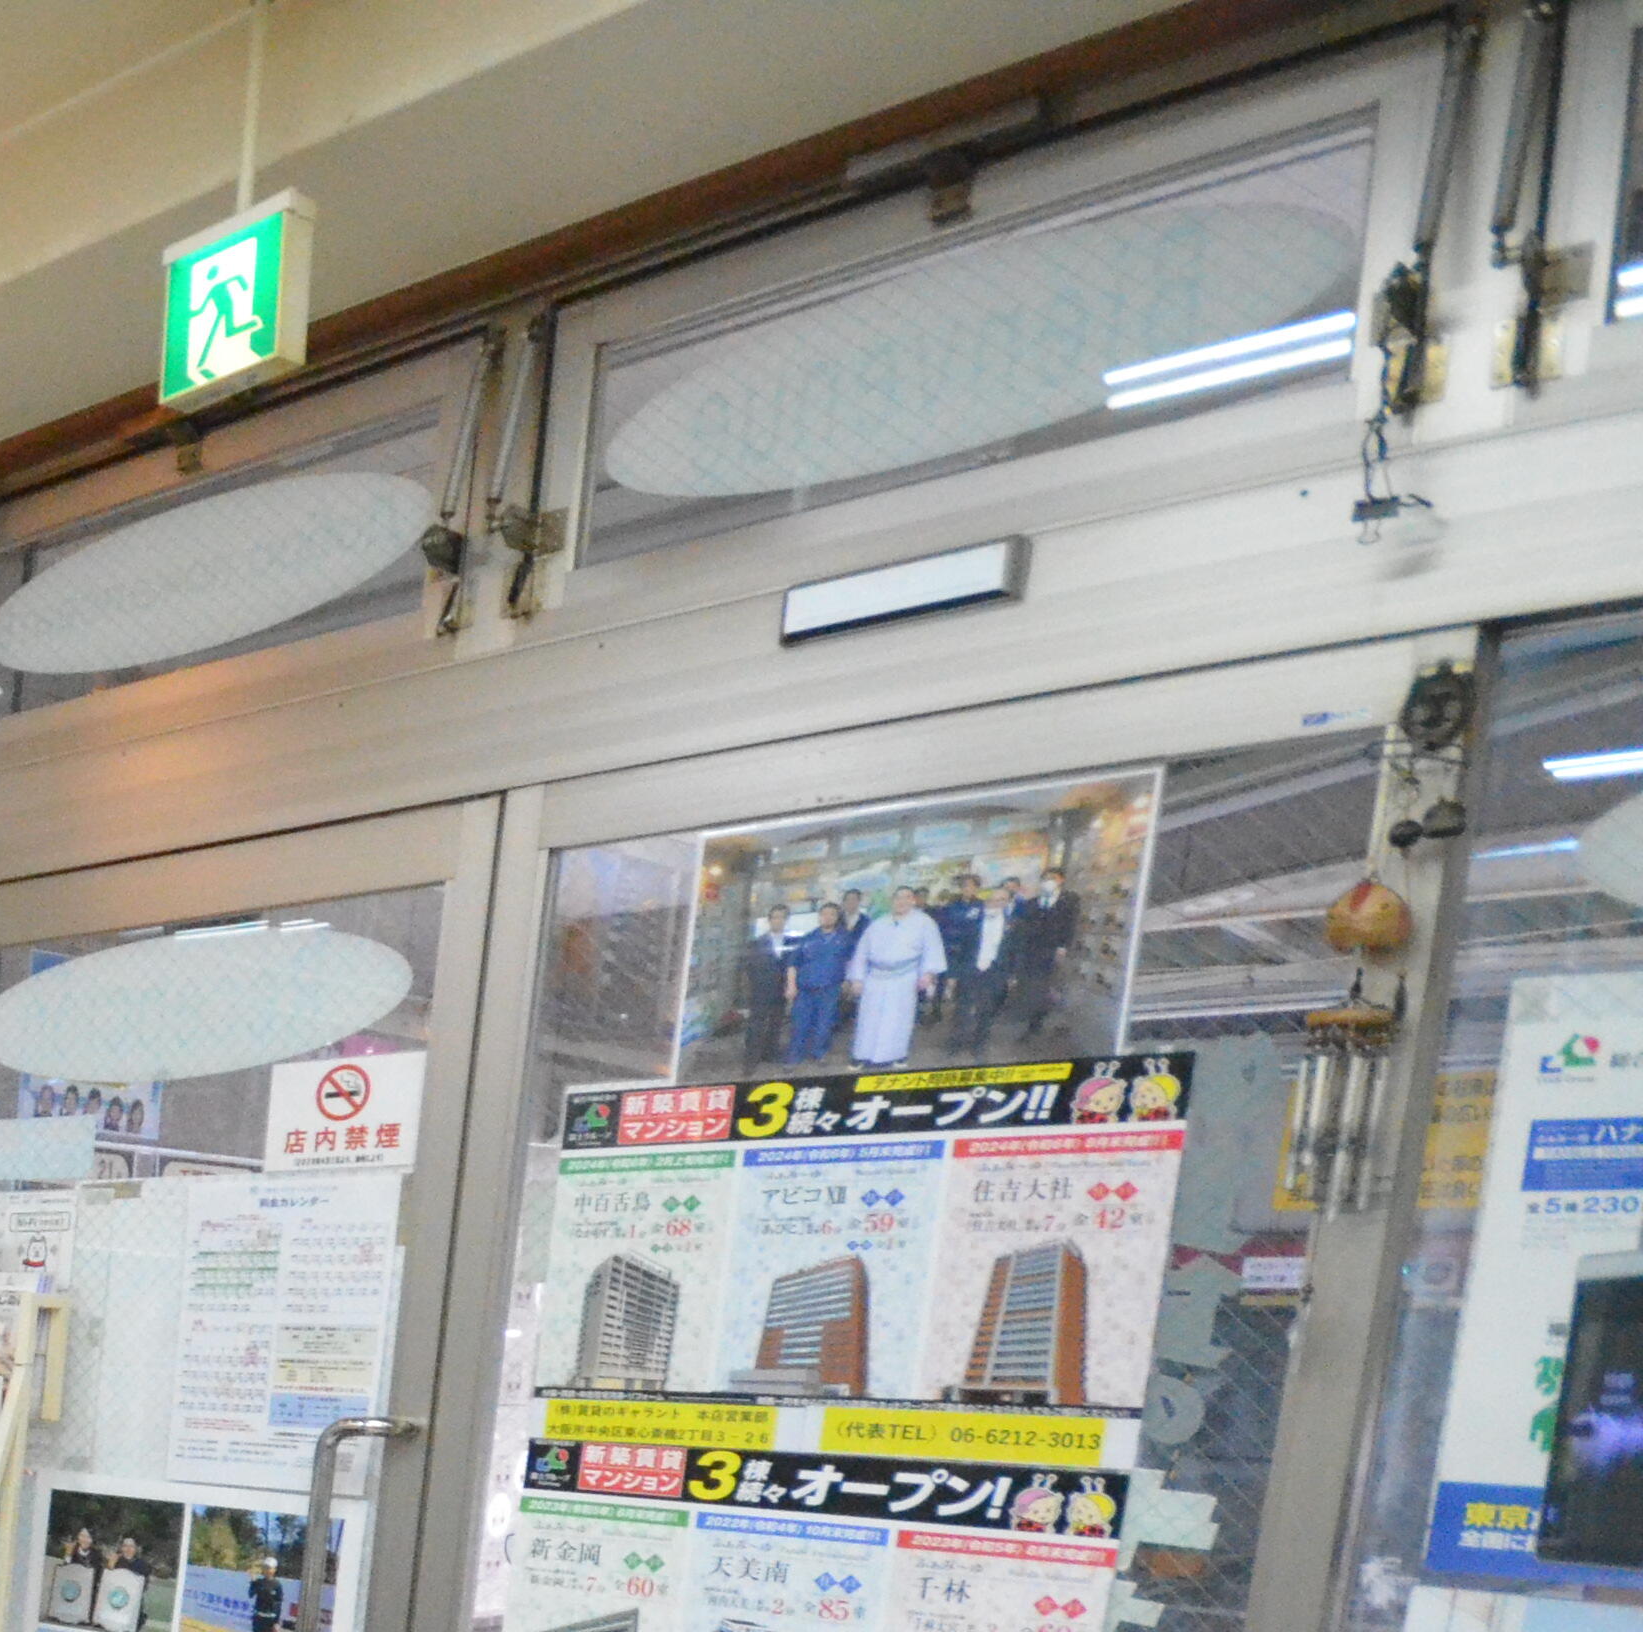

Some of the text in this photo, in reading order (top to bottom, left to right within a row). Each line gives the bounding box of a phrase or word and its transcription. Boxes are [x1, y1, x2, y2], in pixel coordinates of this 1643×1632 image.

[623, 1085, 732, 1116] 新築賃貸
[737, 1083, 794, 1138] 3
[845, 1084, 1059, 1131] オープン!!
[284, 1122, 401, 1155] 店内禁煙
[622, 1115, 729, 1140] マンション
[950, 1427, 1102, 1450] 06-6212-3013
[583, 1469, 681, 1491] マンション
[584, 1445, 683, 1471] 新築賃貸
[688, 1450, 743, 1501] 3
[792, 1463, 1013, 1520] オープン!
[530, 1538, 602, 1566] 新金岡
[709, 1554, 791, 1584] 天美南
